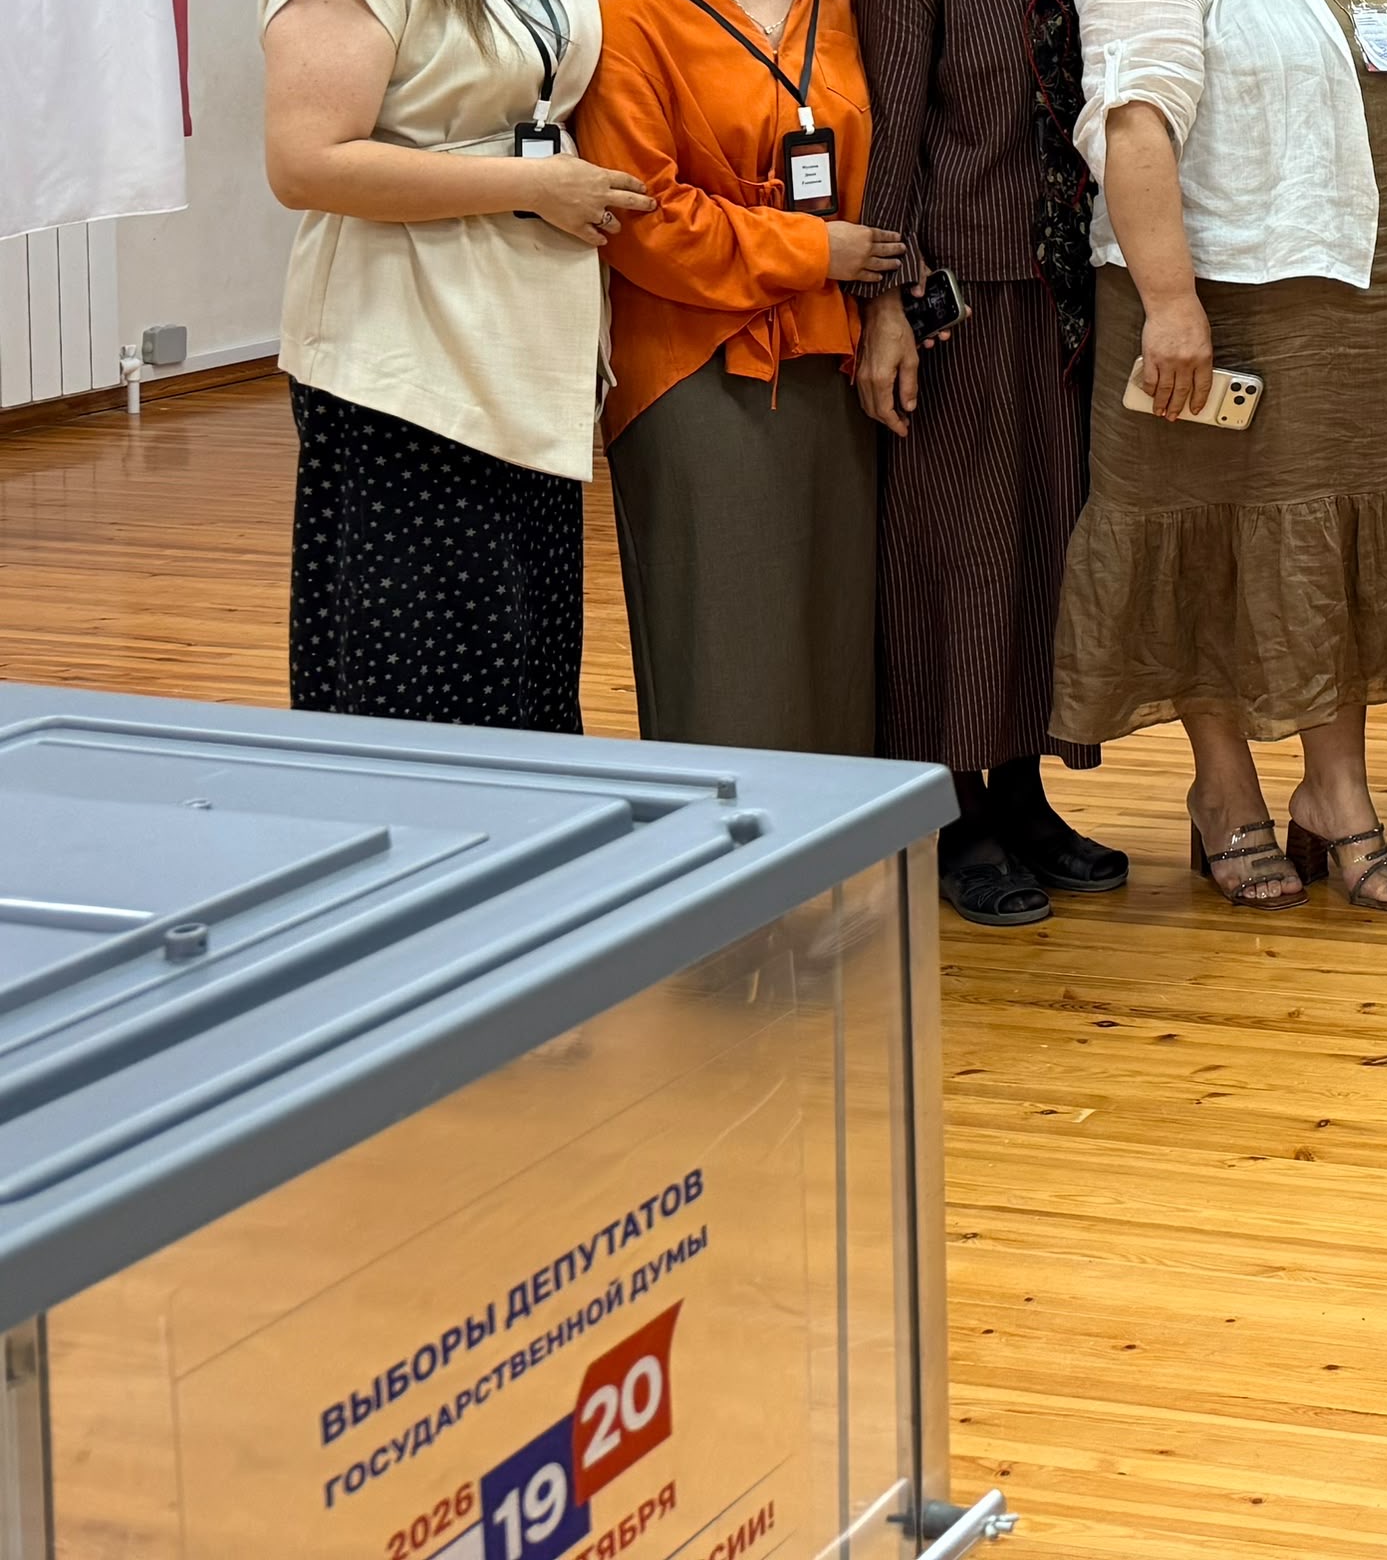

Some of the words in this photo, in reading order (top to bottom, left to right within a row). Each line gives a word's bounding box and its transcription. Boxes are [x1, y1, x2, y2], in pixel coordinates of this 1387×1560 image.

[320, 1302, 497, 1446] ВЫБОРЫ
[505, 1168, 704, 1330] ДЕПУТАТОВ
[325, 1278, 624, 1508] ГОСУДАРСТВЕННОЙ
[629, 1224, 708, 1302] ДУМЫ
[385, 1480, 474, 1560] 2026
[492, 1461, 568, 1560] 19
[580, 1354, 663, 1470] 20
